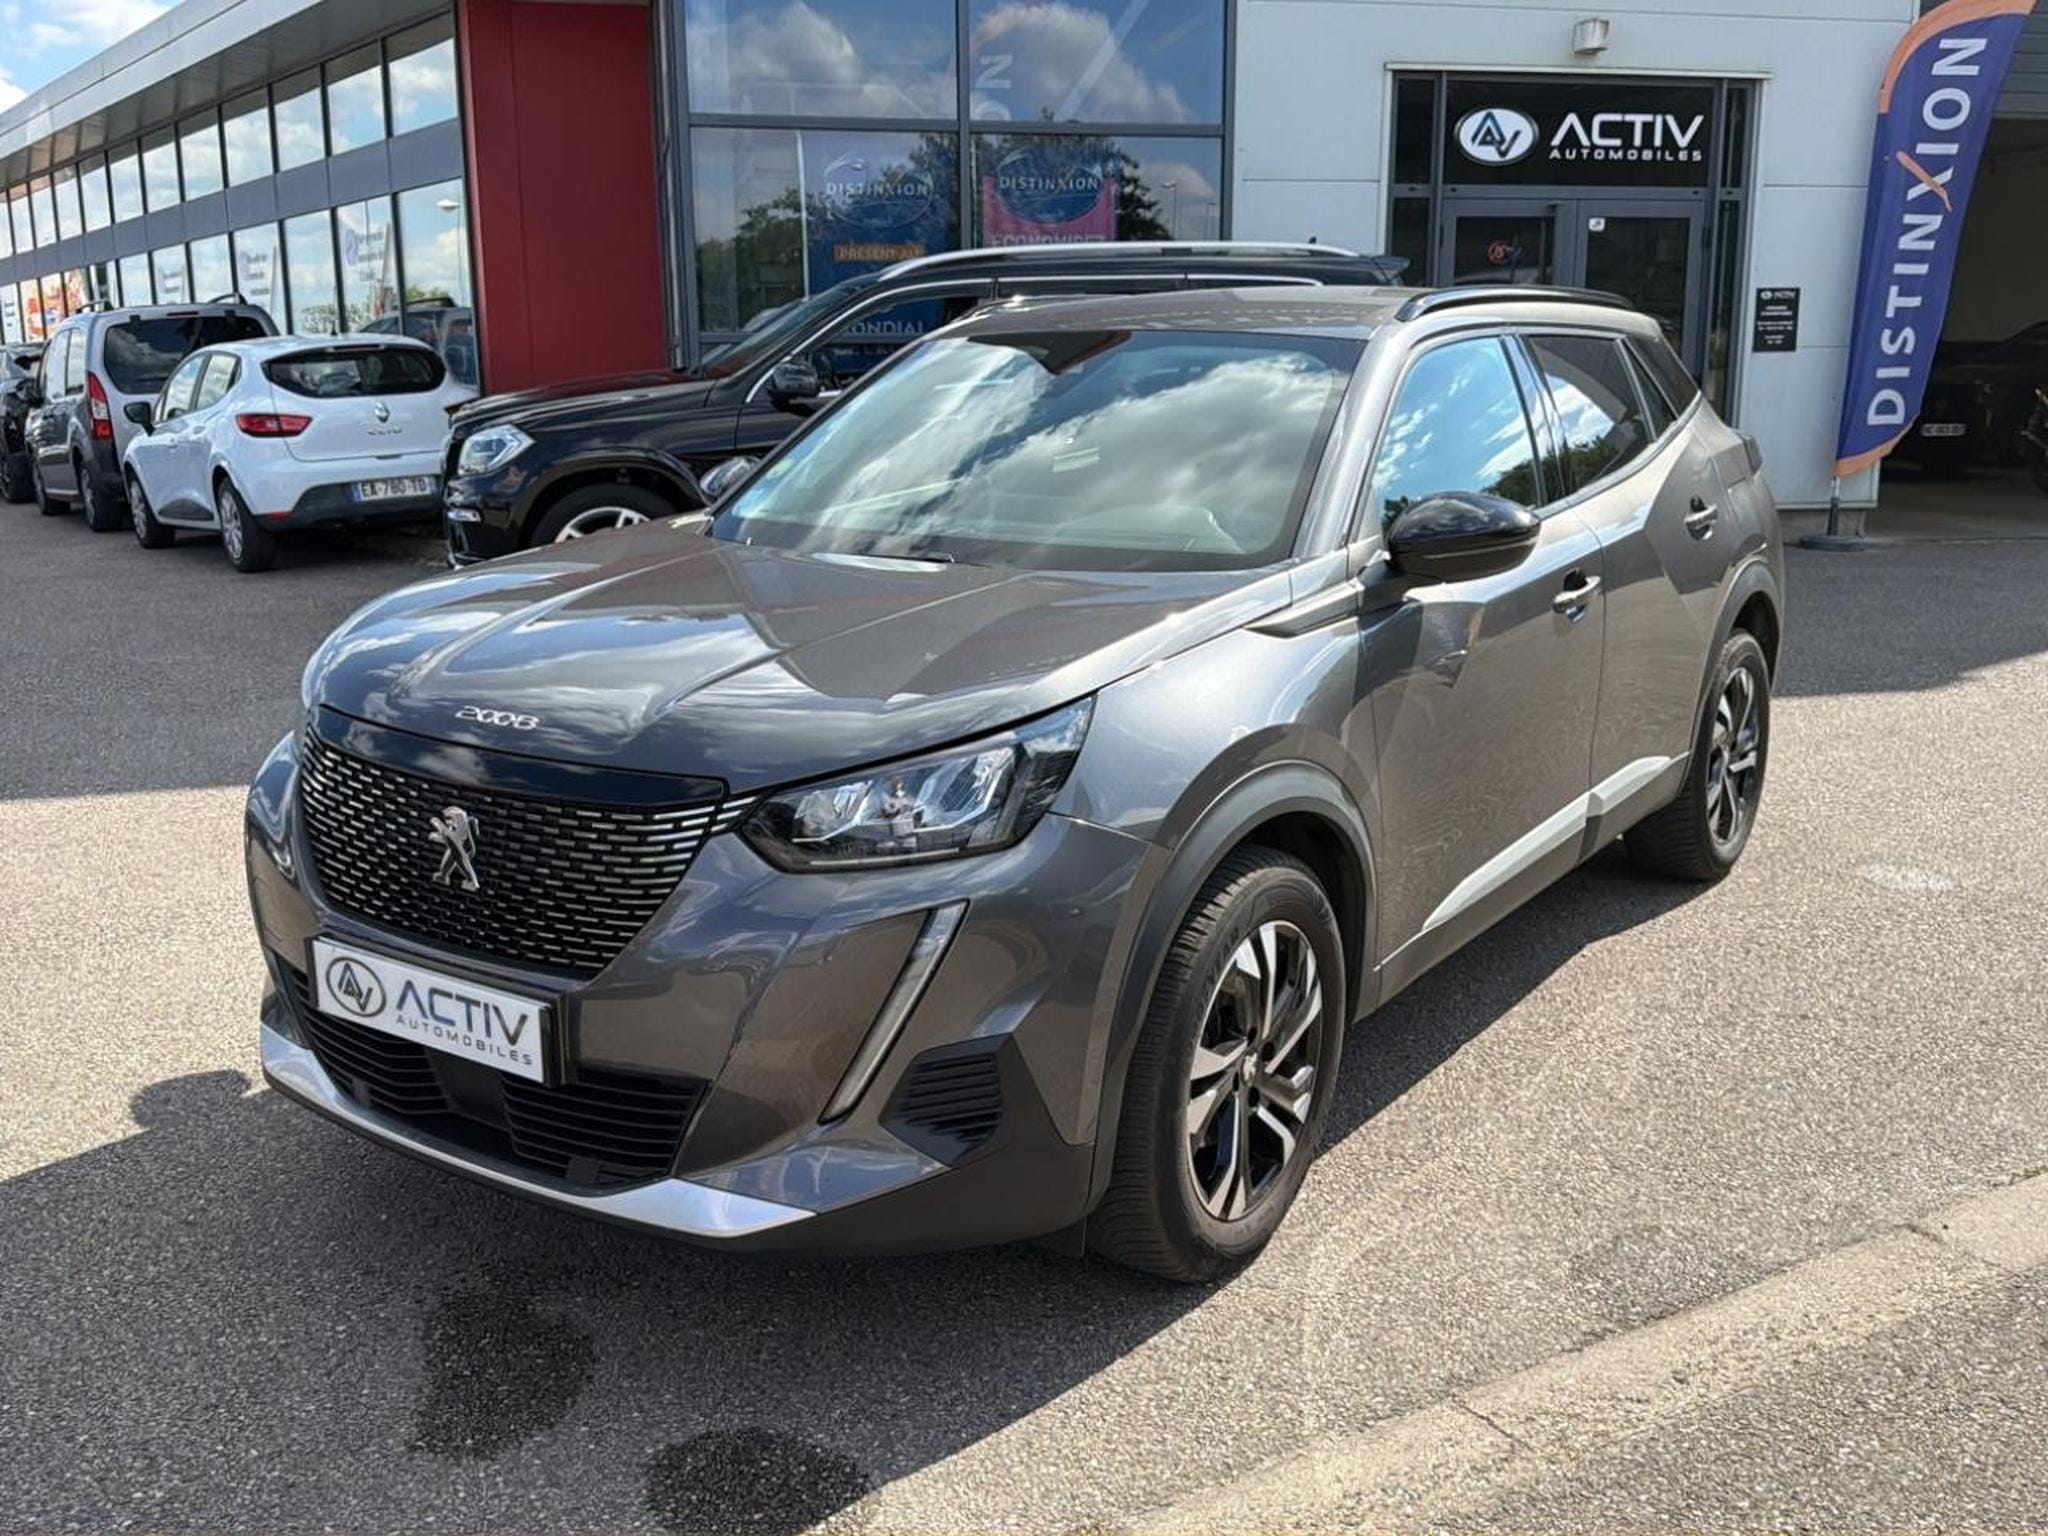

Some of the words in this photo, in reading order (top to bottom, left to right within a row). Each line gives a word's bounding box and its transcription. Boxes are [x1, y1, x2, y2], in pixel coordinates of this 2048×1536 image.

[1550, 112, 1705, 148] ACTIV
[1549, 149, 1702, 162] AUTOMOBILES
[999, 174, 1099, 191] DISTINXION
[1867, 38, 1988, 426] DISTINXION
[454, 705, 540, 731] 2008
[396, 979, 528, 1047] ACTIV
[396, 1015, 533, 1066] AUTOMOBILES
